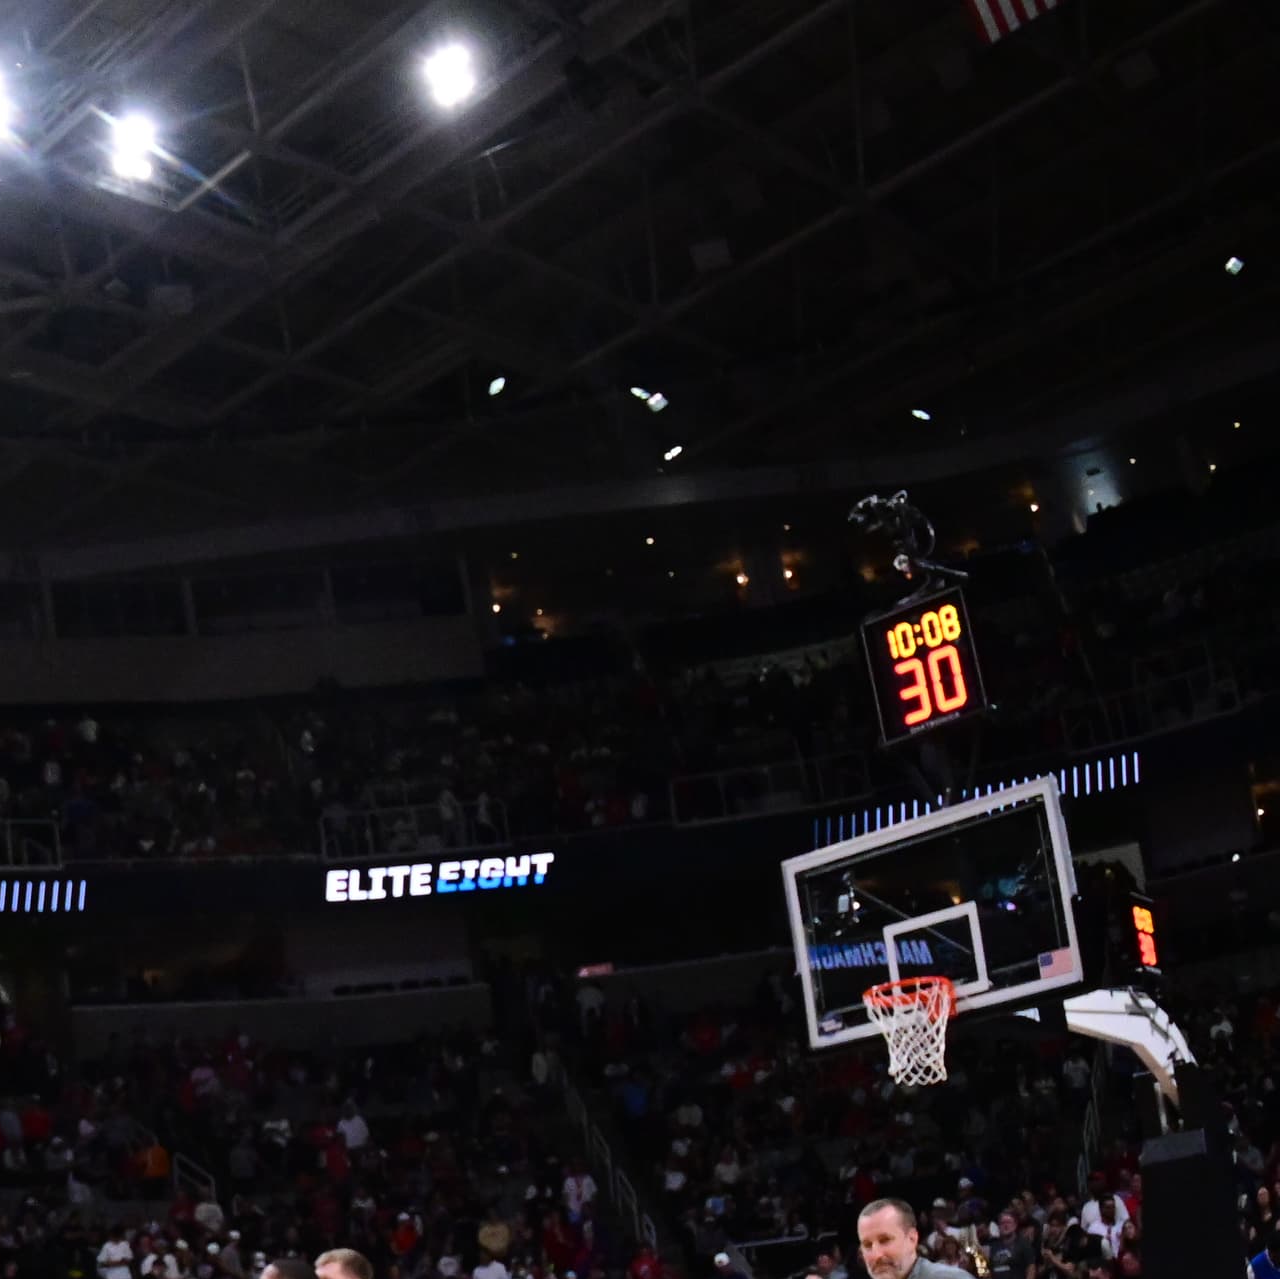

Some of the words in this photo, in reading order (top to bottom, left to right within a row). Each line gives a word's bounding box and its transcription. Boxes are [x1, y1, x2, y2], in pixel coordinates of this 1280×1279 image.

[887, 604, 961, 659] 10:08
[894, 644, 968, 726] 30
[325, 863, 433, 902] ELITE
[436, 852, 555, 894] EIGHT
